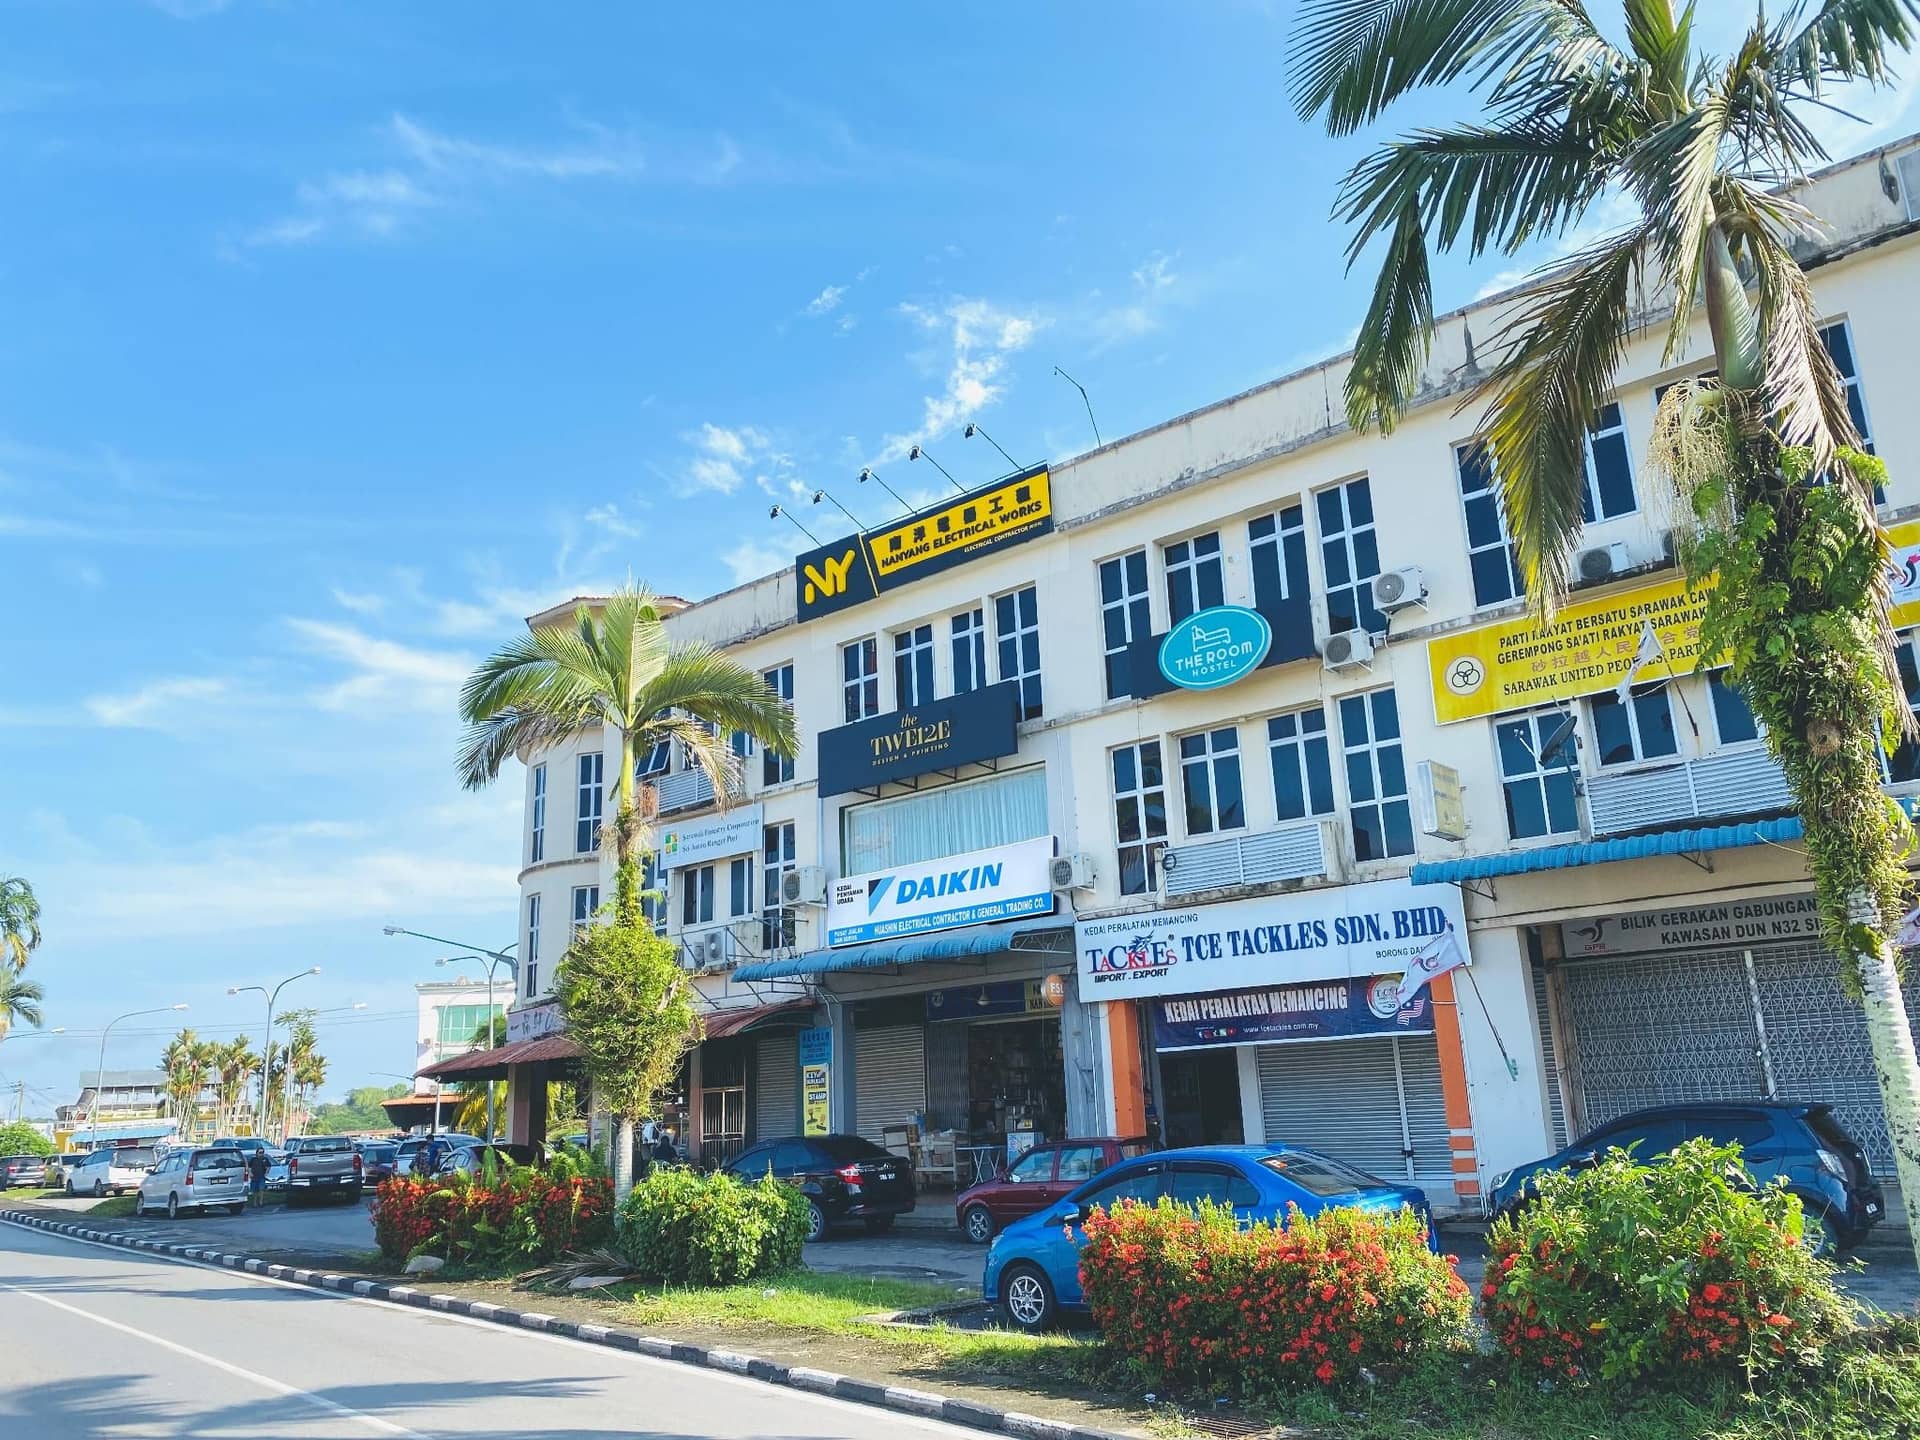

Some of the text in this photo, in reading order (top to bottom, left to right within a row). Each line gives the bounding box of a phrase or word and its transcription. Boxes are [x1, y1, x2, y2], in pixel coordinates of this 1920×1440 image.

[881, 542, 930, 568] NANYANG
[933, 518, 996, 548] ELECTRICAL
[999, 501, 1042, 524] WORKS
[964, 527, 1029, 552] ELECTRICAL CONTRACTOR
[1499, 630, 1529, 648] PARTI
[1576, 608, 1627, 630] BERSATU
[1630, 594, 1686, 618] SARAWAK
[1175, 641, 1253, 671] THE ROOM
[1497, 640, 1563, 664] GEREMPONG
[1192, 660, 1237, 677] HOSTEL
[1503, 673, 1558, 696] SARAWAK
[1560, 664, 1604, 684] UNITED
[900, 713, 918, 728] the
[911, 742, 949, 757] PRINTING
[896, 862, 1003, 904] DAIKIN
[898, 916, 931, 932] ELECTRICAL
[932, 911, 970, 926] CONTRACTOR
[977, 904, 1004, 919] GENERAL
[1006, 899, 1033, 914] TRADING
[1084, 913, 1198, 937] KEDAI PERALATAN MEMANCING
[1620, 897, 1817, 930] BILIK GERAKAN GABUNGAN
[1181, 932, 1223, 962] TCE
[1226, 919, 1328, 957] TACKLES
[1334, 913, 1390, 946] SDN.
[1661, 927, 1731, 945] KAWASAN
[1735, 922, 1767, 938] DUN
[1771, 919, 1801, 935] N32
[1375, 947, 1408, 959] BORONG
[1094, 968, 1169, 983] IMPORT EXPORT
[1164, 998, 1200, 1023] KEDAI
[1201, 993, 1268, 1020] PERALATAN
[1270, 986, 1348, 1016] MEMANCING
